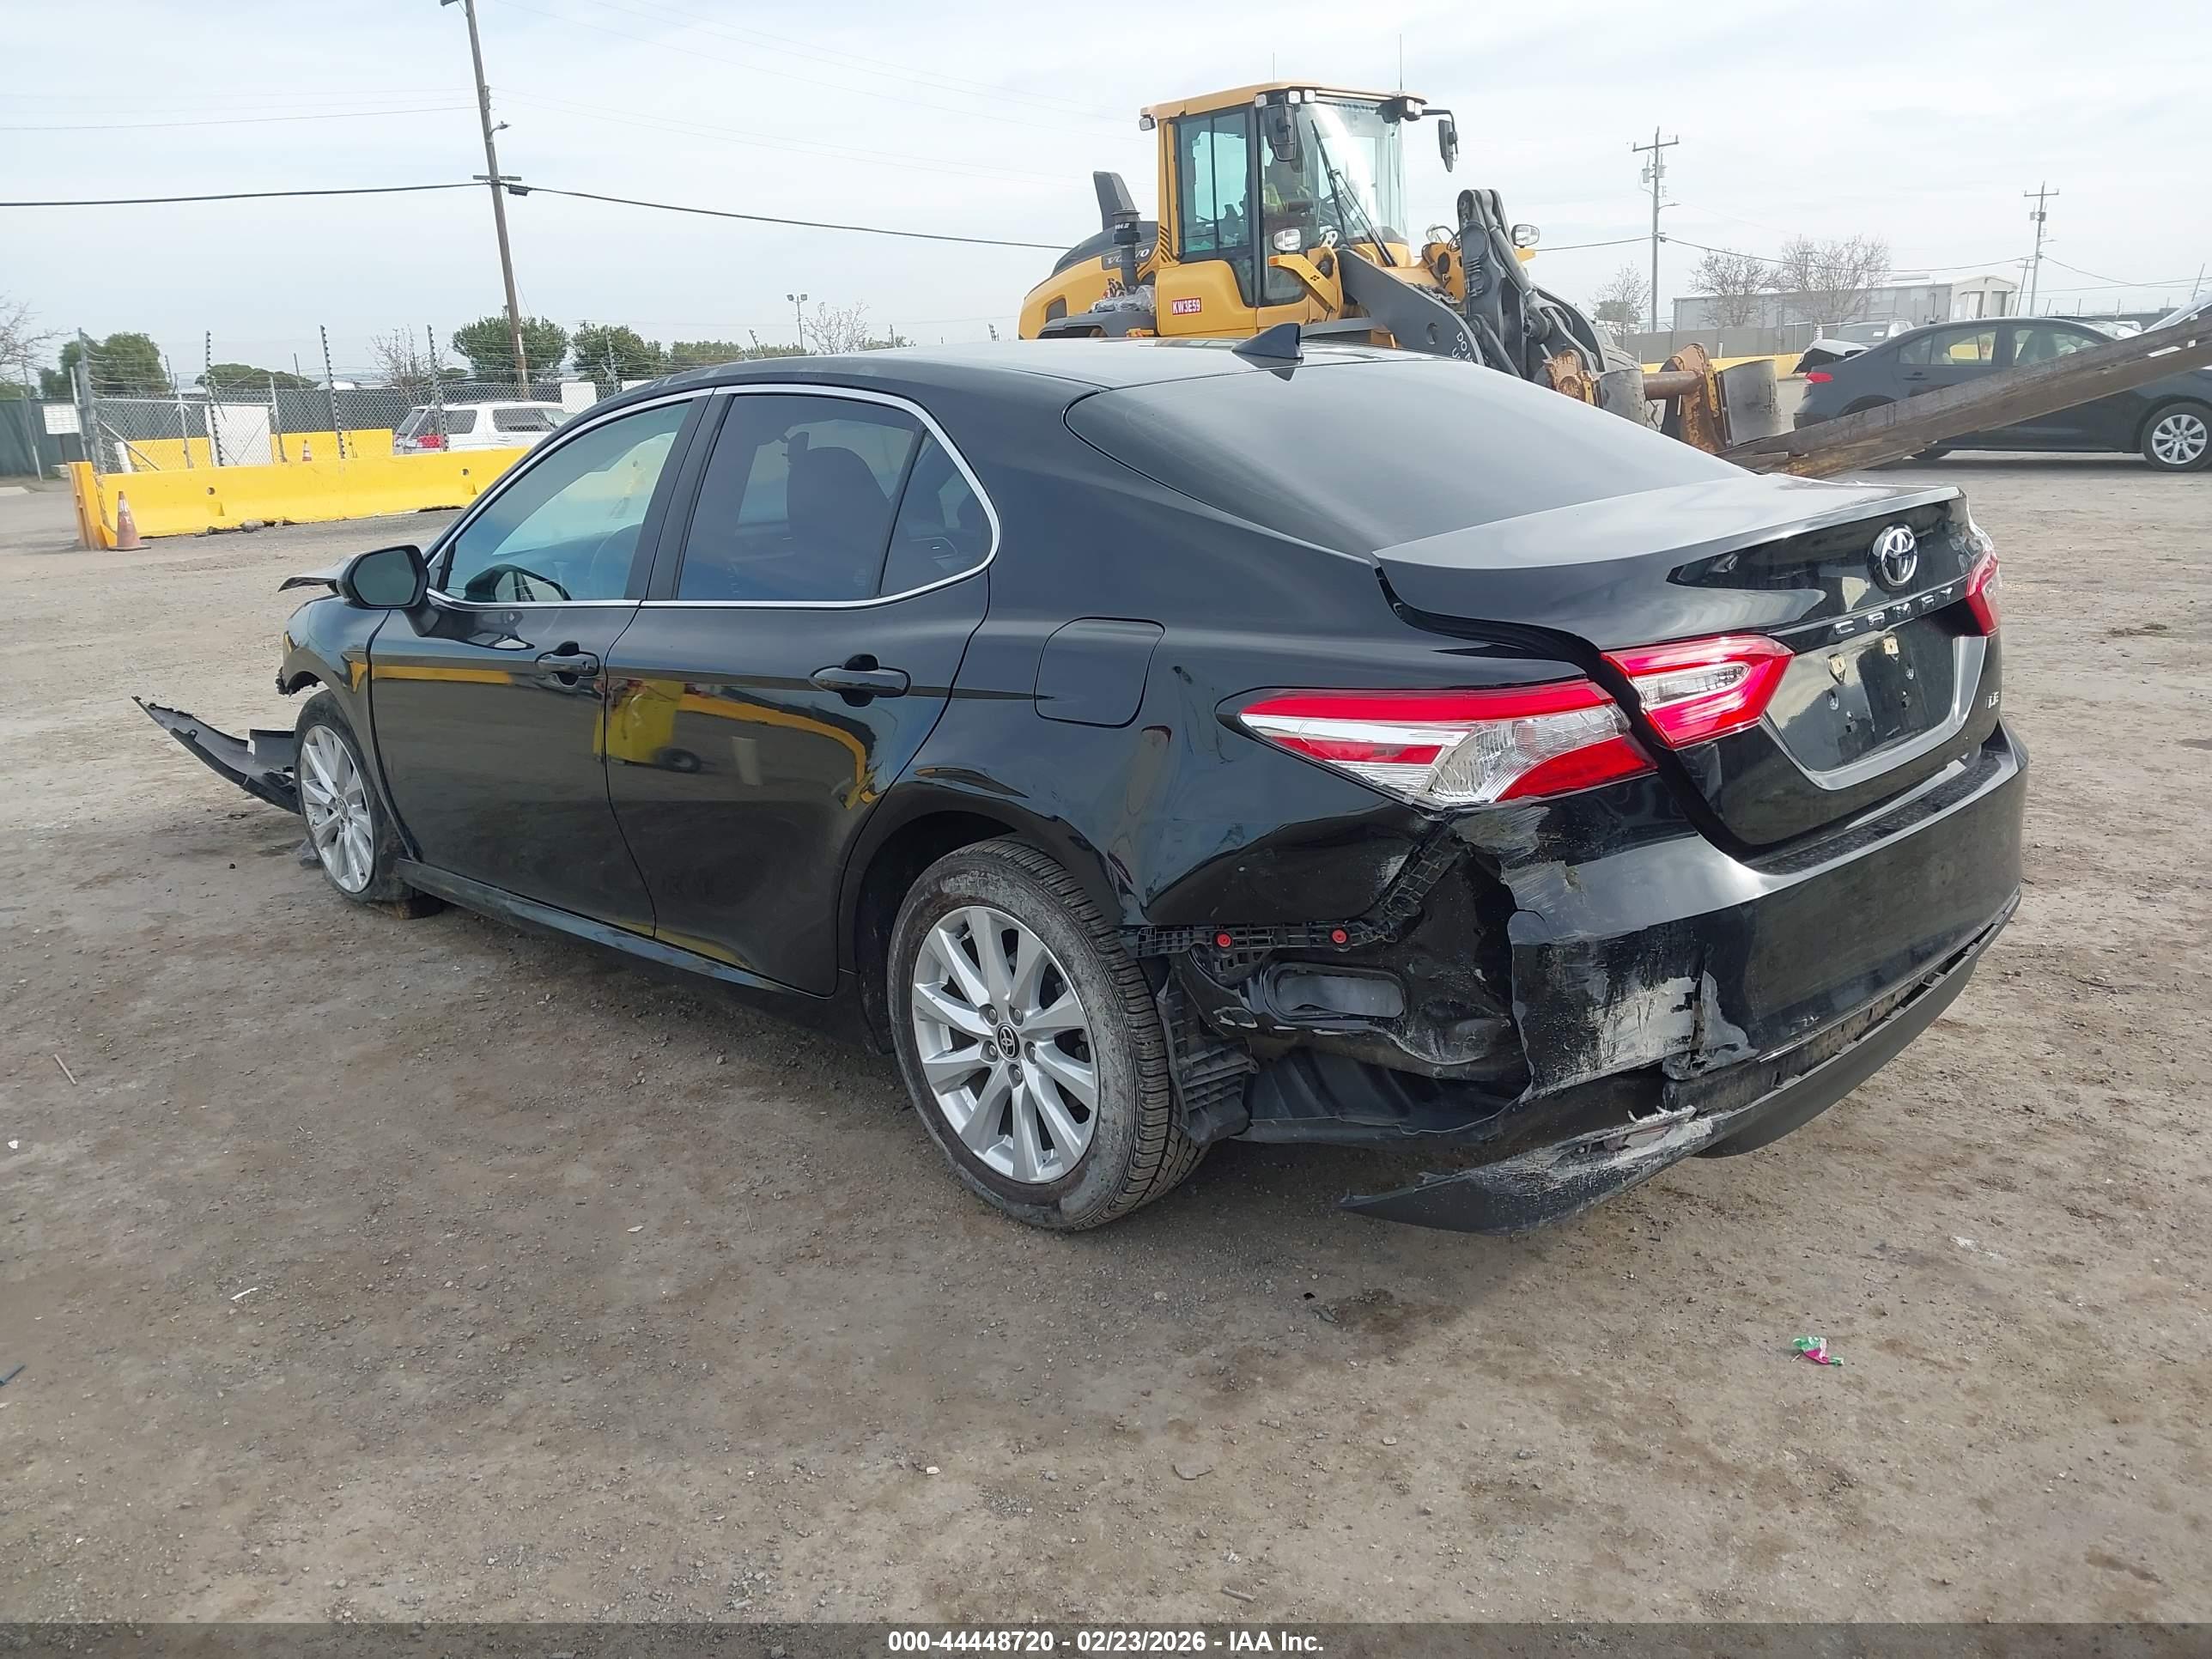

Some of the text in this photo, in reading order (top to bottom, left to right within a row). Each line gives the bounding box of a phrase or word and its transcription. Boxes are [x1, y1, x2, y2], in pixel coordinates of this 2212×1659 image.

[1172, 299, 1200, 313] KW3E59
[1833, 587, 1954, 635] CAMRY
[1985, 690, 2000, 709] LE
